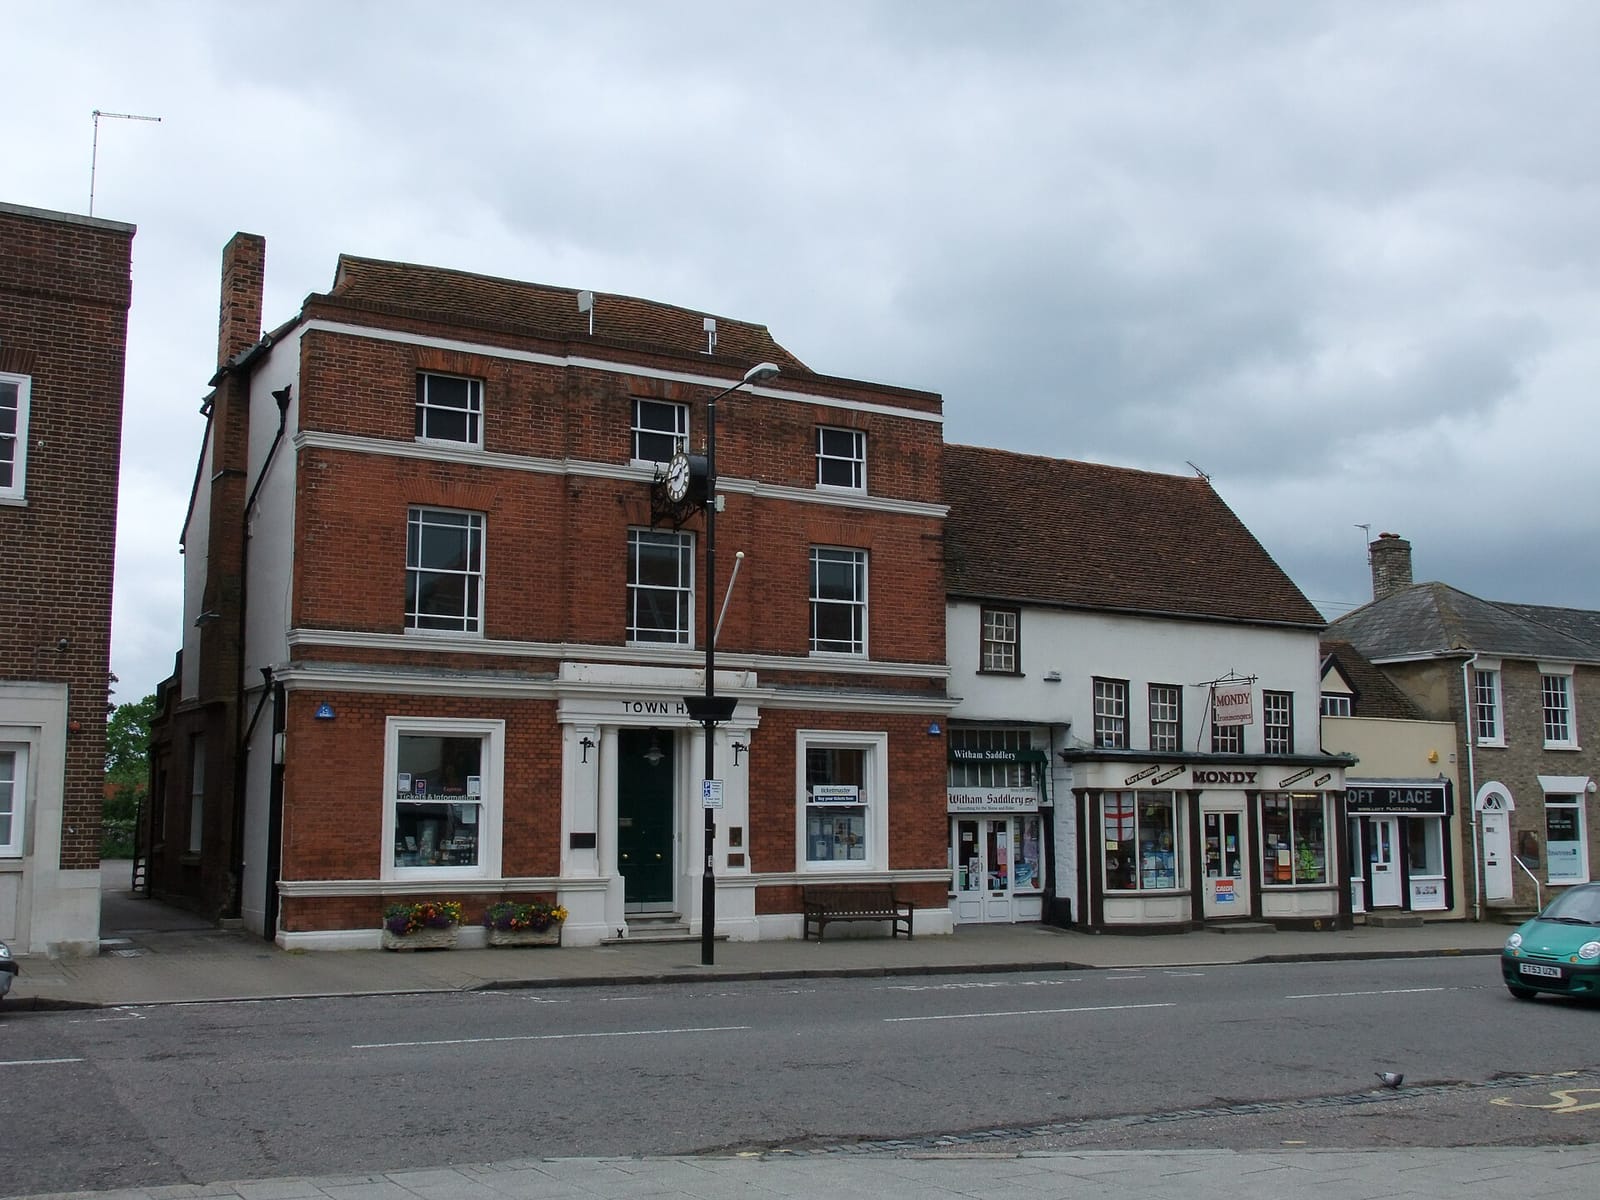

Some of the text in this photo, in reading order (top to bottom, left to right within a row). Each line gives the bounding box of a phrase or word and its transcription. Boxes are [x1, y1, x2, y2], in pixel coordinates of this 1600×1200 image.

[1216, 692, 1250, 707] MONDY
[622, 701, 668, 713] TOWN
[954, 749, 1016, 760] Witham Saddlery
[1192, 771, 1257, 784] MONDY
[400, 793, 425, 801] Tickets
[949, 793, 1023, 806] Witham Saddlery
[1347, 790, 1433, 804] OFT PLACE
[1523, 964, 1541, 974] ET53
